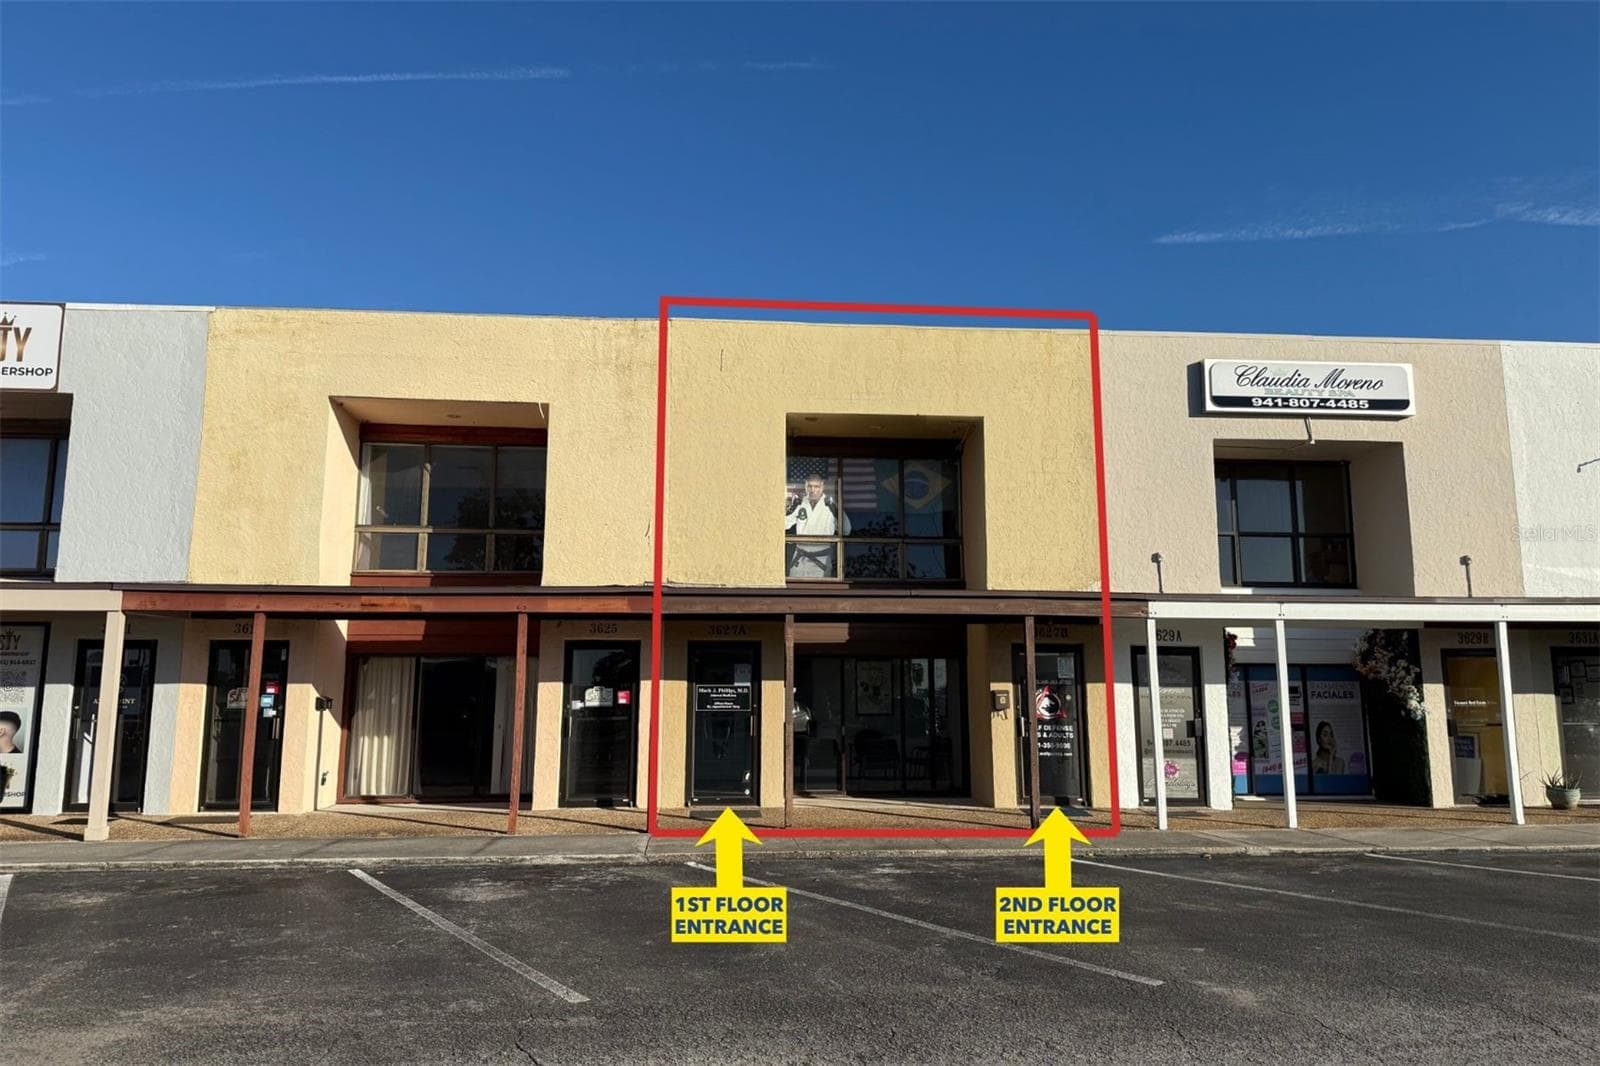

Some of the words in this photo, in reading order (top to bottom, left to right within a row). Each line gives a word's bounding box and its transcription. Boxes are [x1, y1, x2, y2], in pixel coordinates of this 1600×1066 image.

[1, 366, 53, 376] ERSHOP
[1234, 365, 1310, 388] Claudia
[1314, 368, 1384, 391] Moreno
[1264, 388, 1324, 396] BEAUTY
[1328, 389, 1356, 397] SPA
[1251, 397, 1370, 409] 941-807-4485
[589, 623, 618, 634] 3625
[707, 624, 747, 635] 3627A
[1156, 629, 1182, 642] 629A
[1311, 690, 1354, 699] FACIALES
